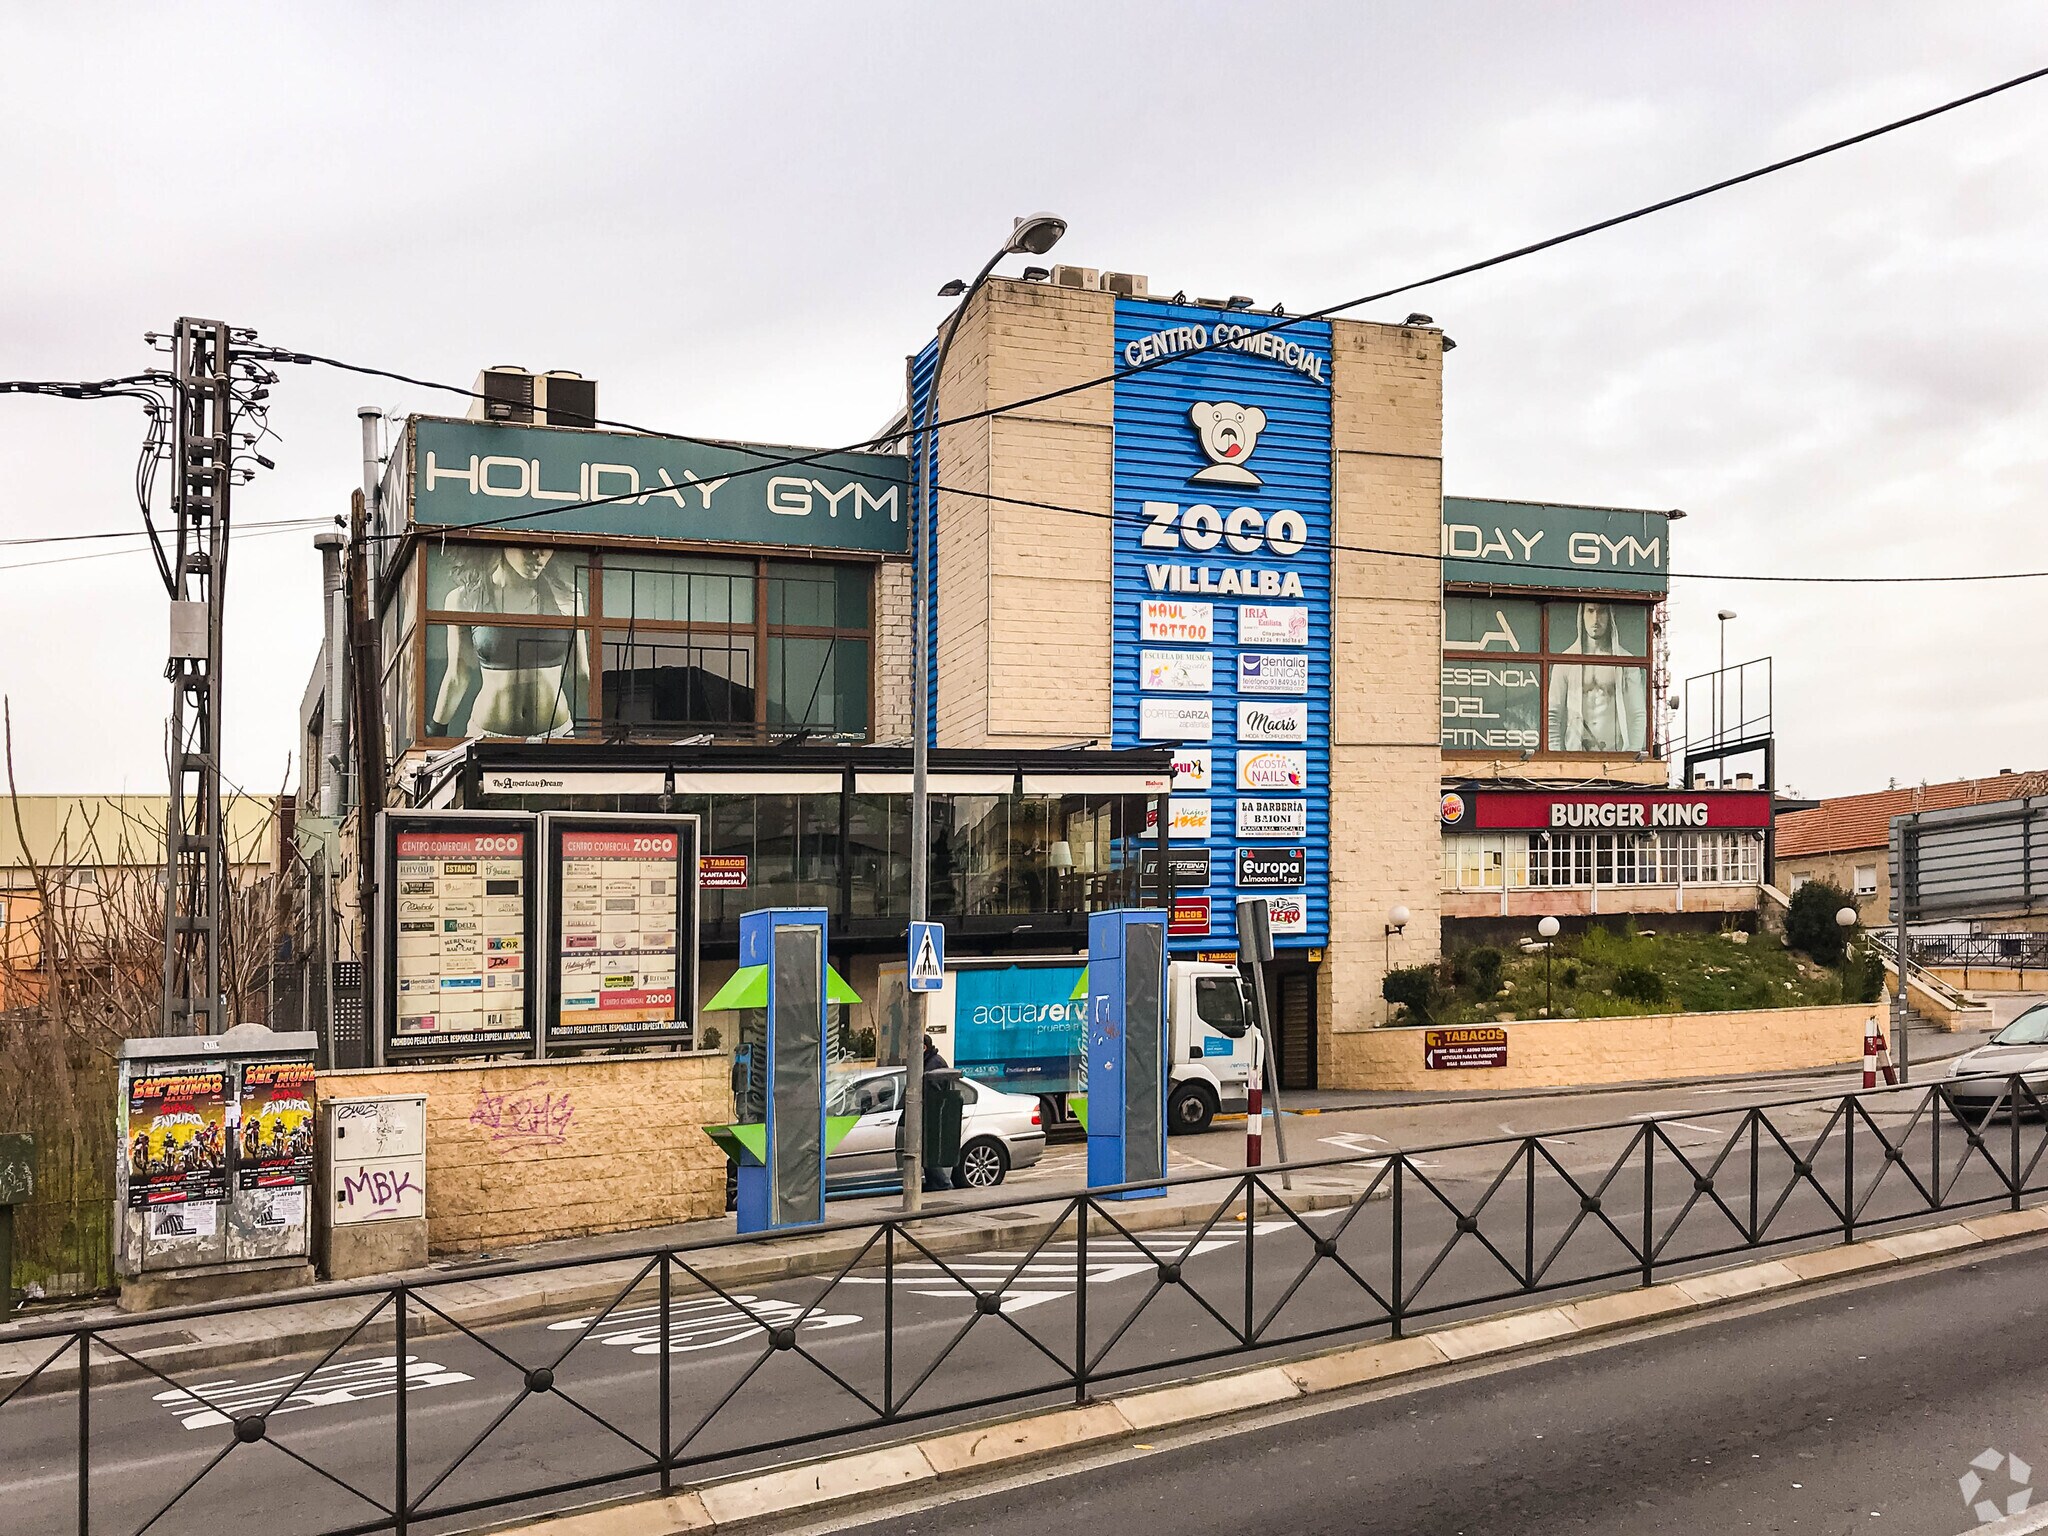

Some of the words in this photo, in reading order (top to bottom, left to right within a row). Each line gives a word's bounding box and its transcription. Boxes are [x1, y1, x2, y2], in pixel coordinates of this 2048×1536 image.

[1124, 324, 1207, 367] CENTRO
[1213, 323, 1325, 384] COMERCIAL
[426, 451, 730, 509] HOLIDAY
[767, 477, 899, 522] GYM
[1141, 501, 1307, 555] ZOCO
[1569, 532, 1660, 568] GYM
[1145, 563, 1304, 597] VILLALBA
[1148, 603, 1186, 619] MAUL
[1245, 608, 1268, 618] IRIA
[1150, 623, 1206, 639] TATTOO
[1443, 610, 1520, 652] LA
[1144, 652, 1174, 660] ESCUELA
[1262, 656, 1306, 667] dentalia
[1442, 696, 1500, 719] DEL
[1247, 711, 1298, 733] Macris
[1442, 728, 1540, 748] FITNESS
[1252, 760, 1287, 769] ACOSTA
[493, 779, 503, 788] The
[503, 777, 540, 789] American
[540, 779, 563, 788] Dream
[1252, 771, 1287, 782] NAILS
[1242, 803, 1254, 812] LA
[1256, 801, 1303, 812] BARBERÍA
[1443, 806, 1462, 816] KING
[1254, 815, 1291, 823] BAIONI
[1551, 803, 1645, 827] BURGER
[1651, 803, 1708, 827] KING
[402, 841, 430, 851] CENTRO
[431, 841, 471, 851] COMERCIAL
[475, 838, 518, 852] ZOCO
[568, 841, 592, 852] CENTRO
[594, 841, 631, 852] COMERCIAL
[633, 839, 673, 852] ZOCO
[446, 864, 475, 873] ESTANCO
[1243, 860, 1300, 879] europa
[1242, 875, 1279, 883] Almacenes
[645, 994, 672, 1004] ZOCO
[551, 1027, 573, 1036] PROHIBIDO
[574, 1025, 587, 1035] PEGAR
[1037, 1023, 1070, 1035] prueba
[1445, 1029, 1505, 1042] TABACOS
[391, 1037, 414, 1047] PROHIBIDO
[414, 1036, 428, 1046] PEGAR
[479, 1032, 484, 1042] LA
[484, 1032, 503, 1042] EMPRESA
[133, 1074, 223, 1089] CAMPEONATO
[245, 1073, 274, 1085] DEL
[132, 1085, 165, 1099] DEL
[166, 1082, 223, 1096] MUNDO
[164, 1095, 193, 1103] MAXXIS
[260, 1099, 313, 1118] ENDURO
[152, 1112, 206, 1130] ENDURO
[344, 1169, 423, 1206] MBK
[151, 1354, 476, 1432] BUS
